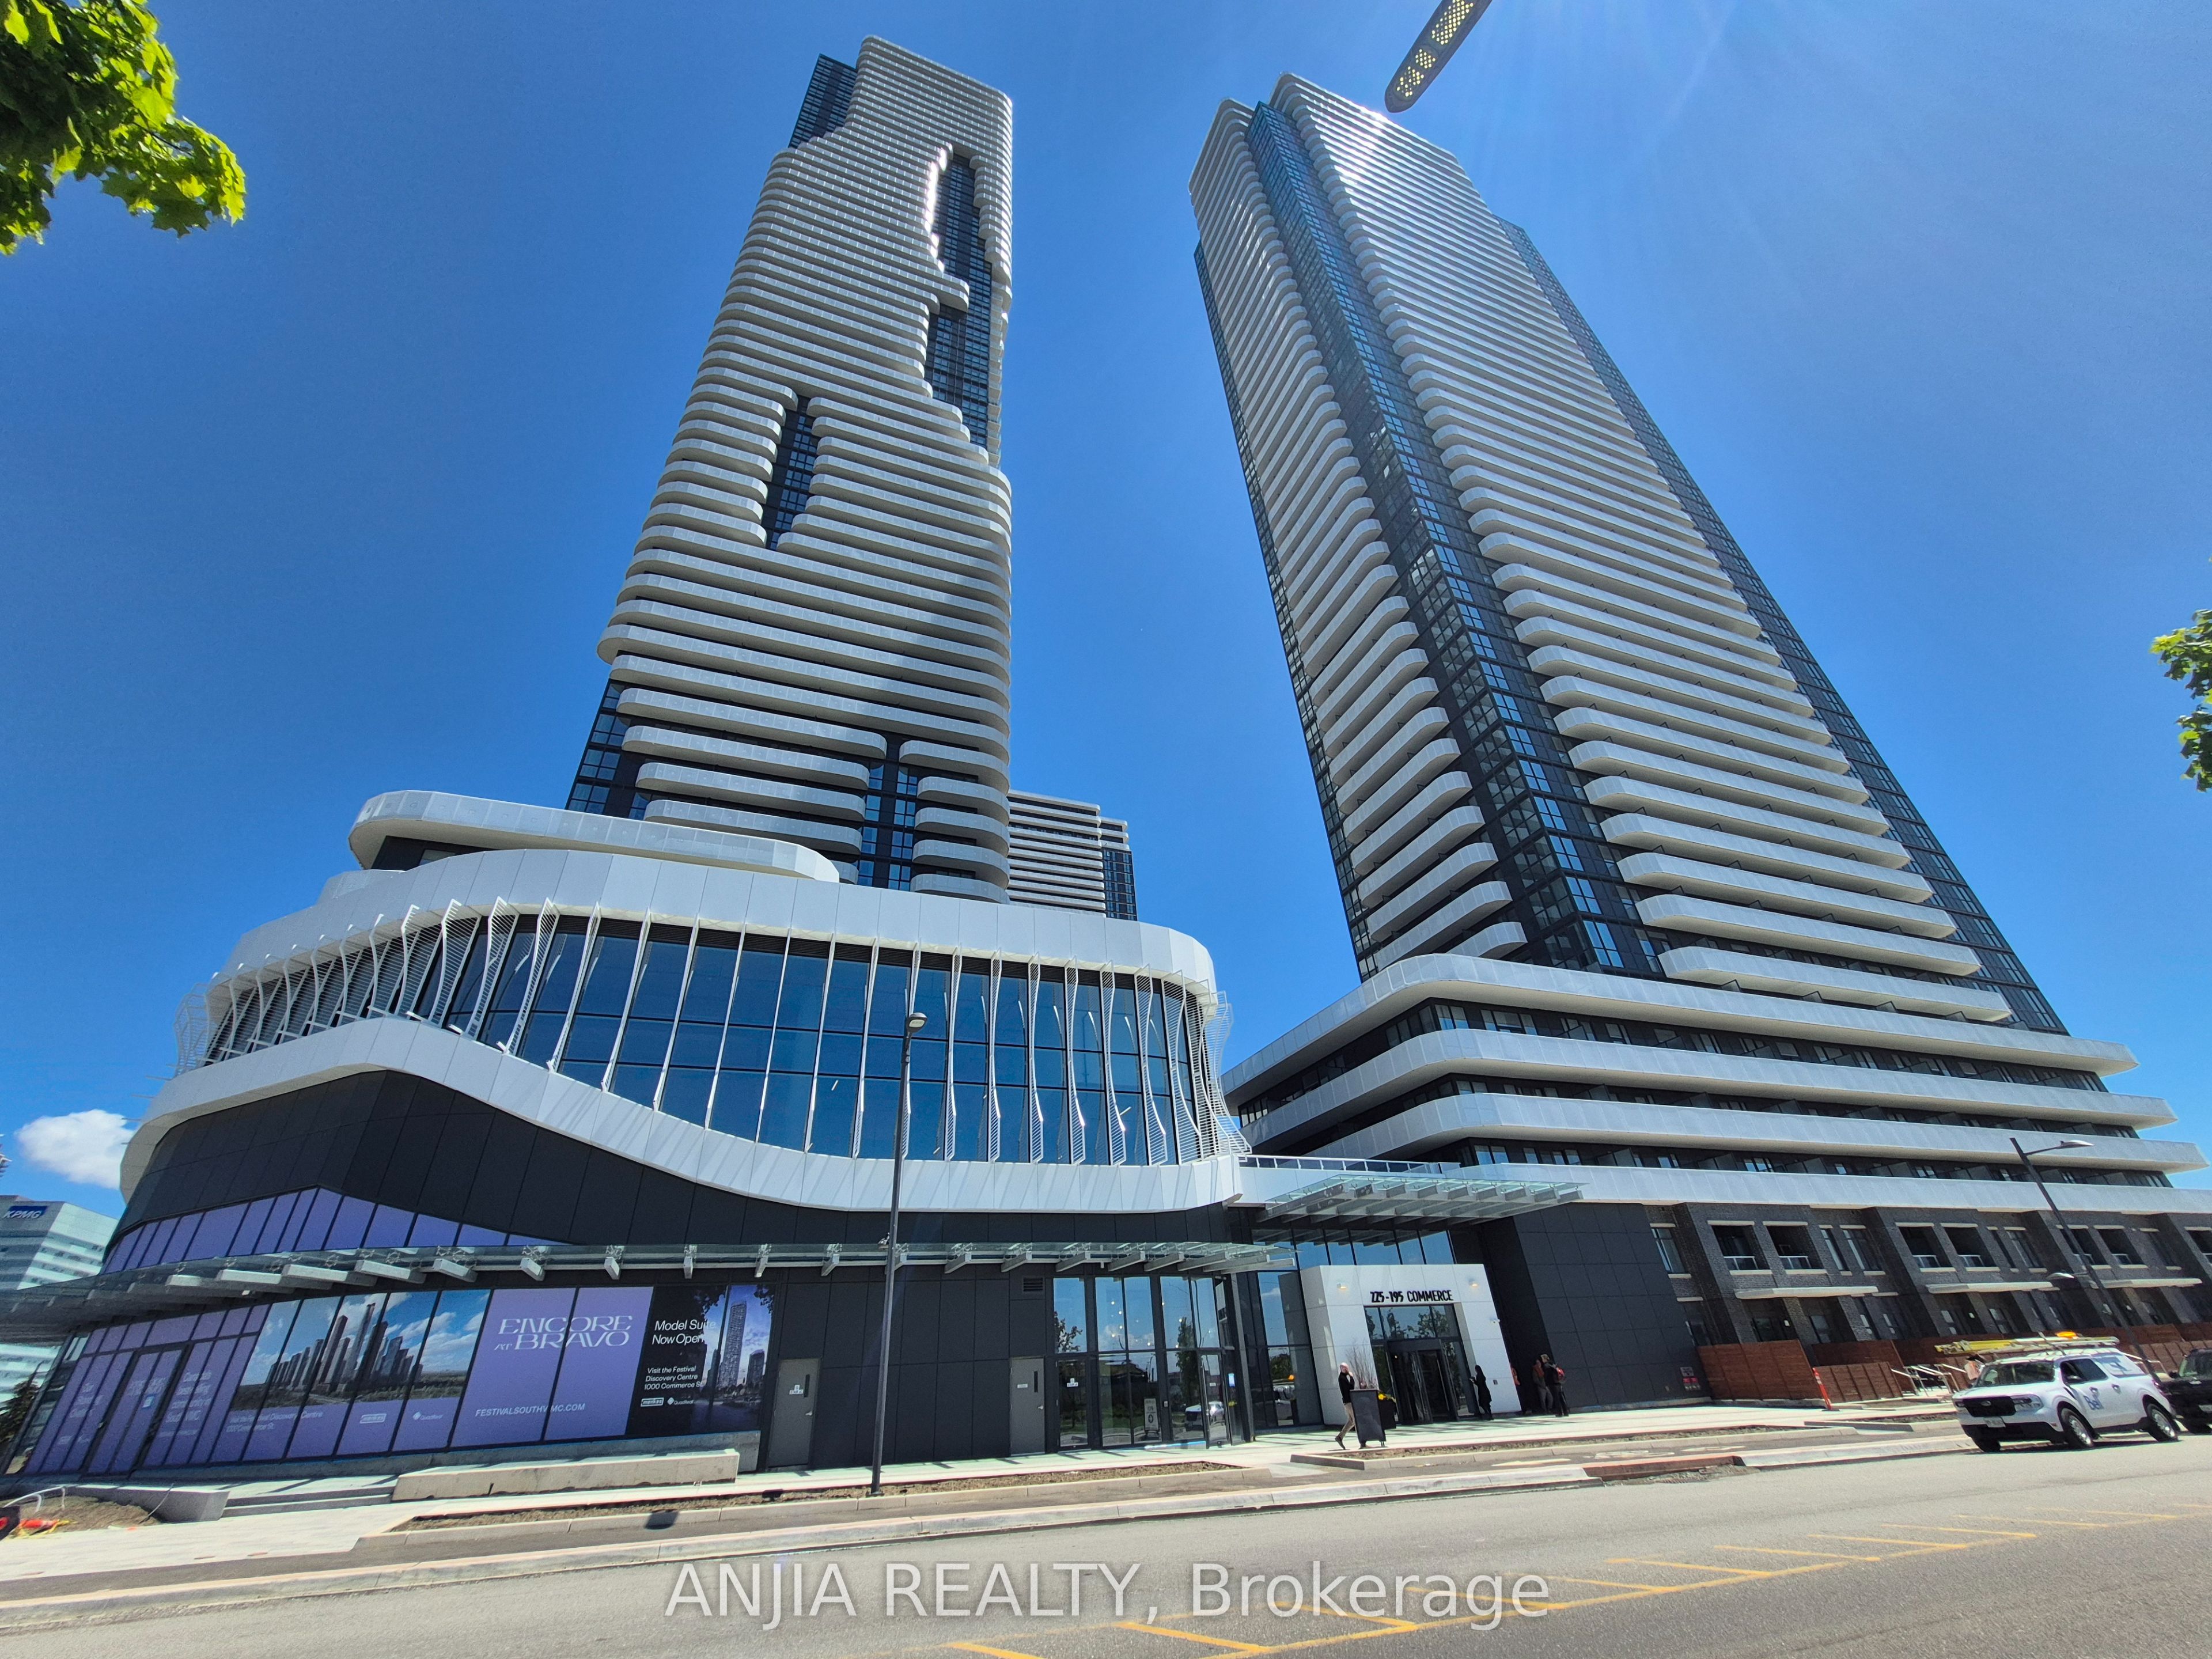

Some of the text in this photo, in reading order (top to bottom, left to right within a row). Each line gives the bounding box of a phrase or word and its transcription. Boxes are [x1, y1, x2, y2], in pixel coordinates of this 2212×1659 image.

[2, 1210, 43, 1218] KPMG
[1407, 1290, 1453, 1302] COMMERCE
[498, 1316, 632, 1334] ENCORE
[654, 1319, 716, 1331] Model Suite
[514, 1331, 630, 1350] BRAVO
[652, 1333, 704, 1346] Now Open
[2082, 1393, 2104, 1410] Bell
